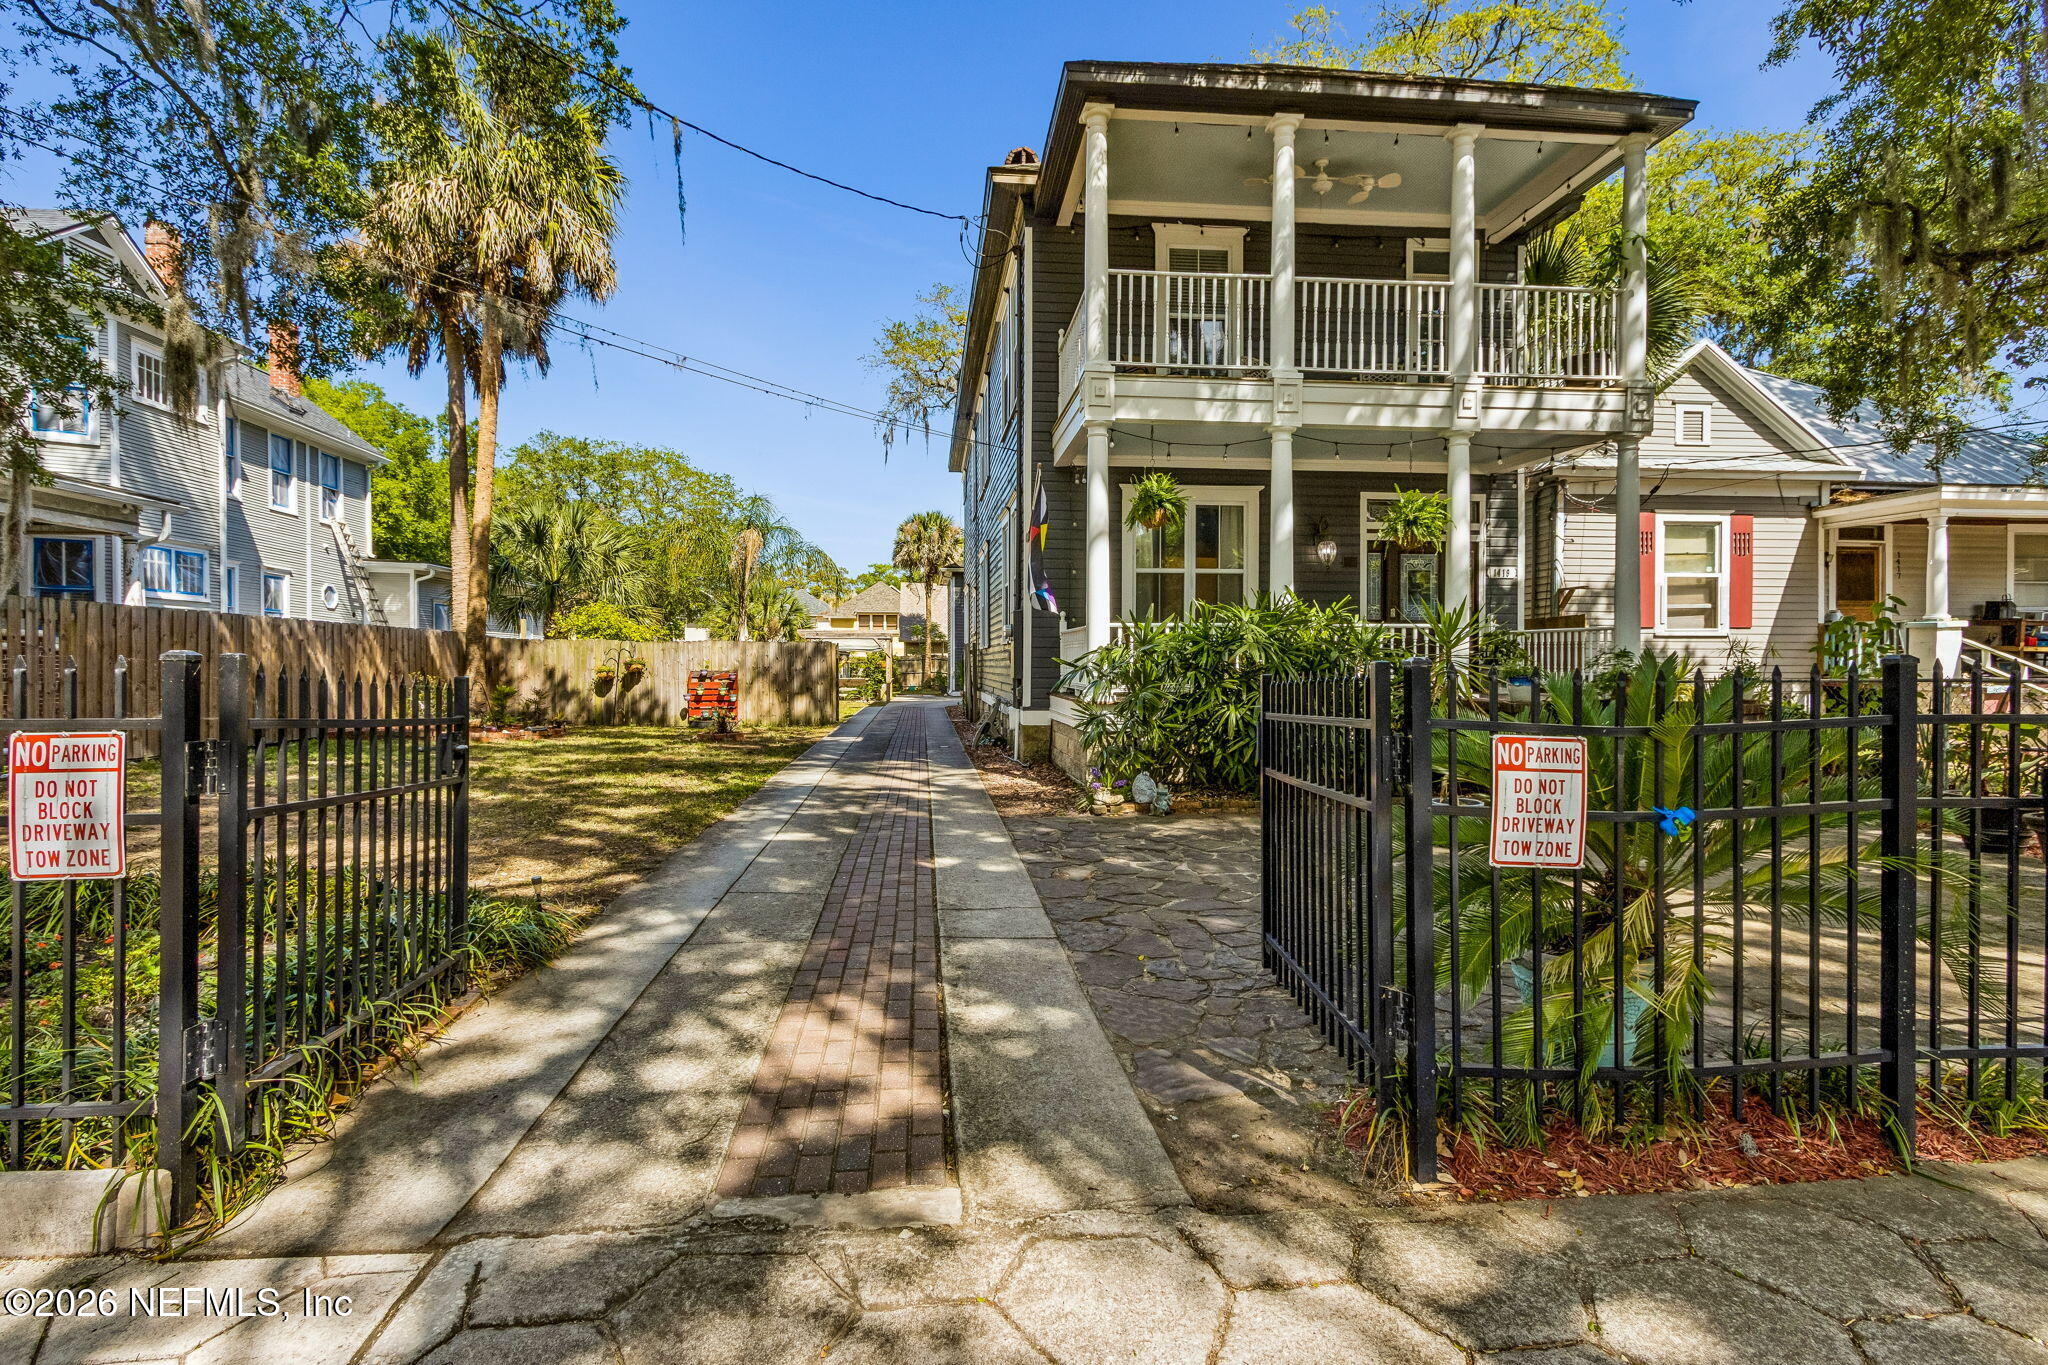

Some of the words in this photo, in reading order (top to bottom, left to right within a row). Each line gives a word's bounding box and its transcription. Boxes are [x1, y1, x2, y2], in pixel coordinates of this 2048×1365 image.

[15, 741, 47, 767] NO
[51, 743, 117, 763] PARKING
[1497, 742, 1524, 765] NO
[1527, 746, 1581, 765] PARKING
[35, 780, 58, 798] DO
[65, 779, 98, 798] NOT
[1514, 778, 1533, 794] DO
[1539, 779, 1566, 795] NOT
[38, 801, 93, 820] BLOCK
[1516, 797, 1562, 815] BLOCK
[22, 822, 111, 842] DRIVEWAY
[1502, 816, 1575, 835] DRIVEWAY
[25, 850, 60, 868] TOW
[66, 849, 111, 867] ZONE
[1503, 840, 1532, 857] TOW
[1535, 841, 1573, 858] ZONE
